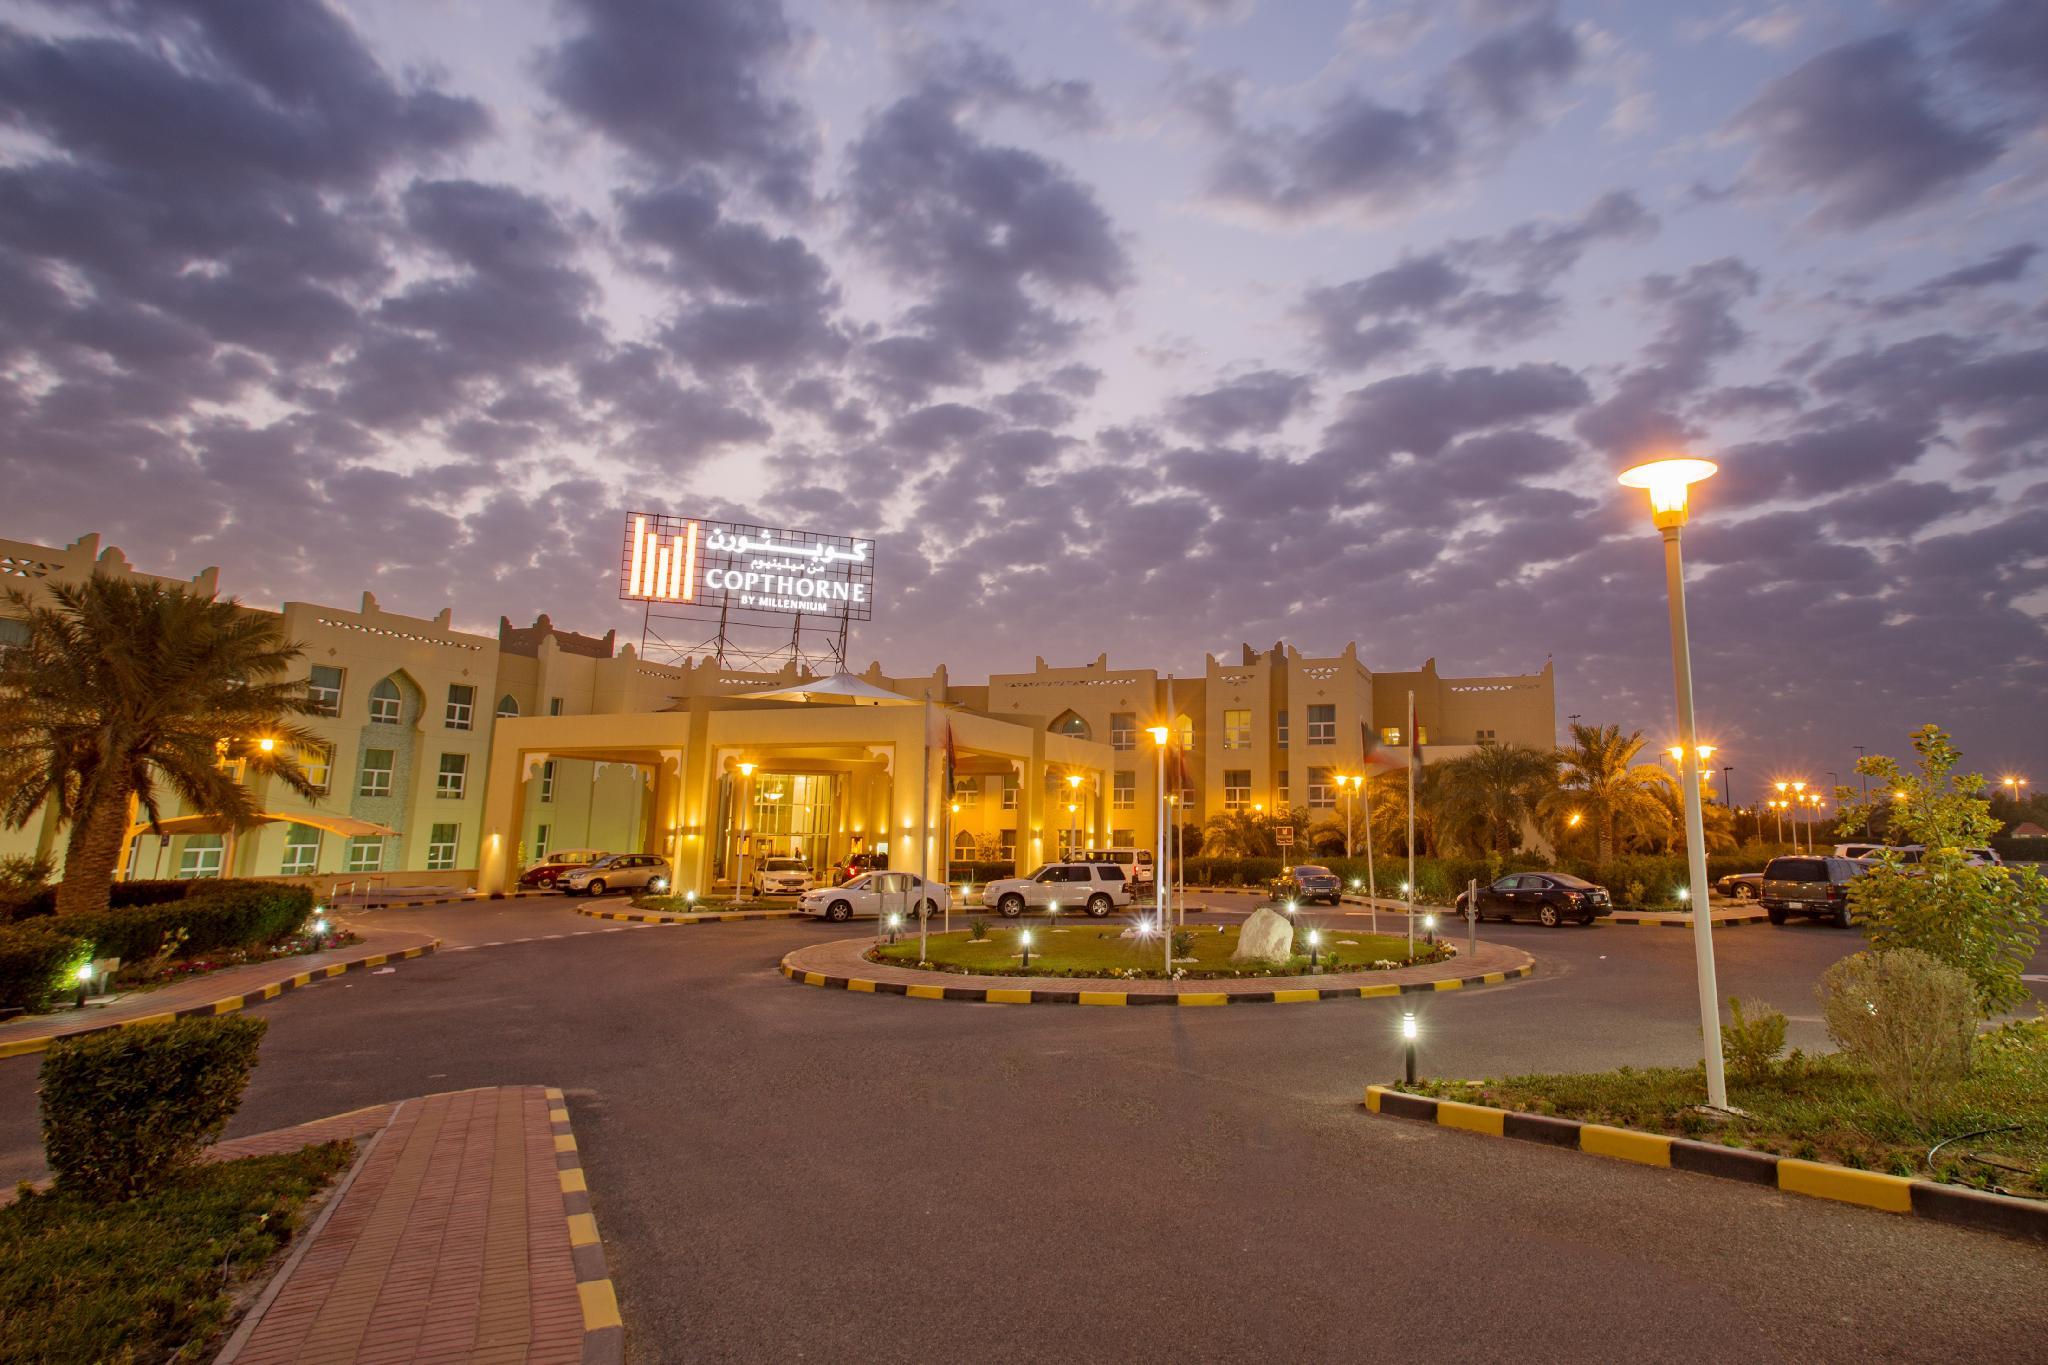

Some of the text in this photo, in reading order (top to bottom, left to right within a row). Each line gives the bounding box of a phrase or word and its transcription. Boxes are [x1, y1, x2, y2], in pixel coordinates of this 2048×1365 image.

[807, 563, 825, 574] من
[705, 568, 865, 602] COPTHORNE
[741, 595, 828, 612] BY MILLENNIUM
